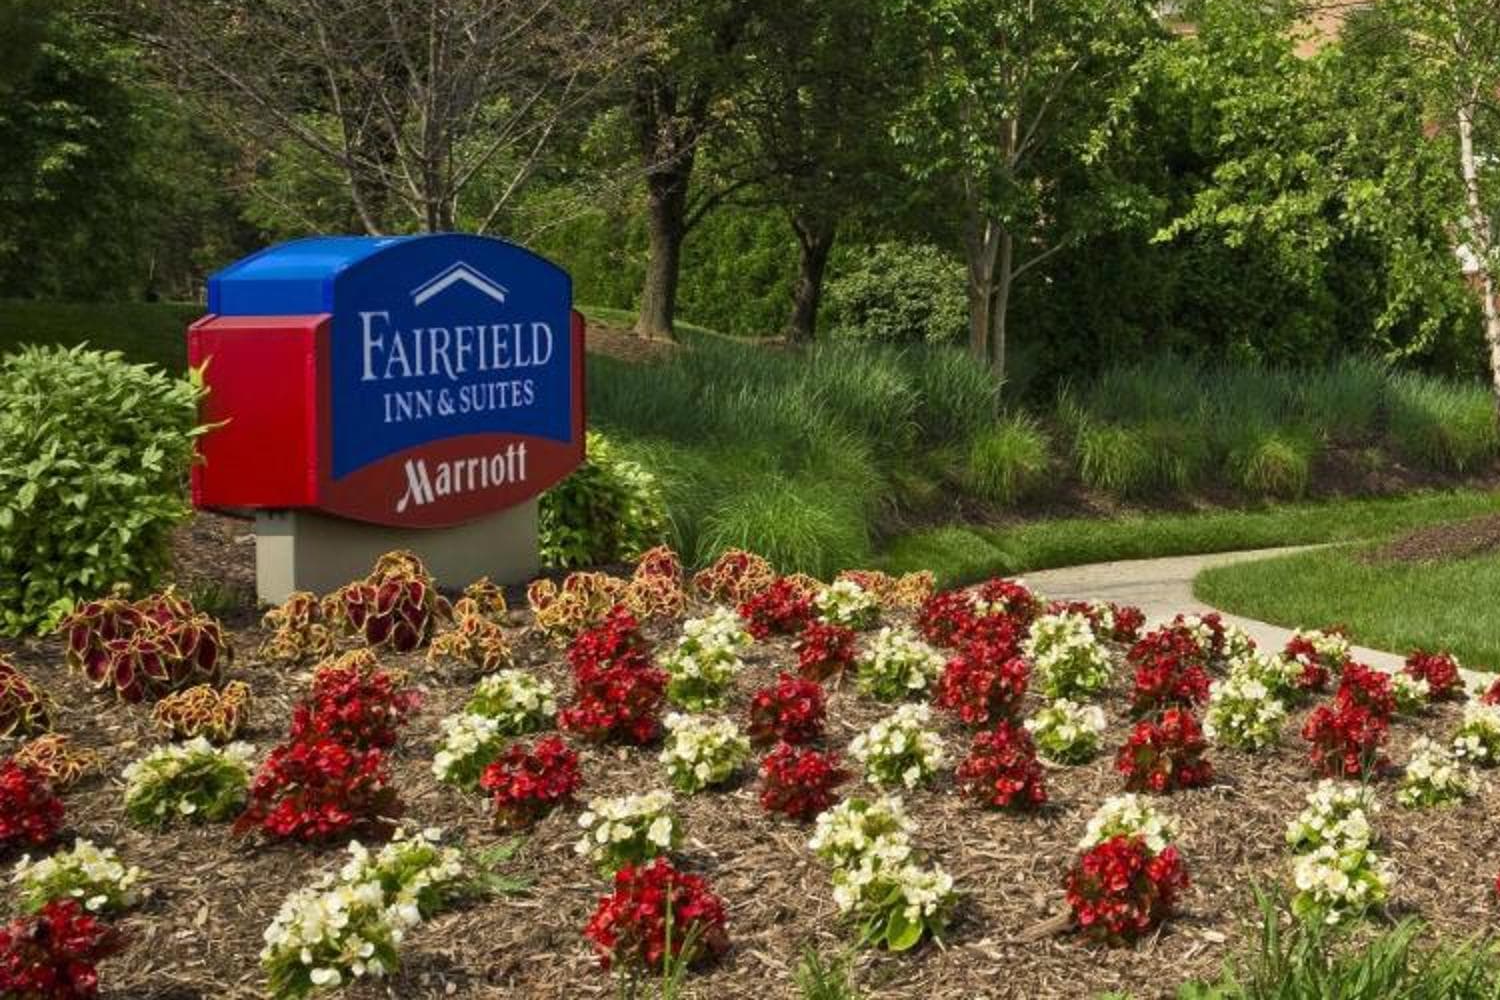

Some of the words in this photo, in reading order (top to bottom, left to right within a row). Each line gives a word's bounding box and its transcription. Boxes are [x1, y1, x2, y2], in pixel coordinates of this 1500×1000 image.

[358, 310, 554, 382] FAIRFIELD
[458, 378, 536, 413] SUITES
[396, 441, 528, 513] Marriott
